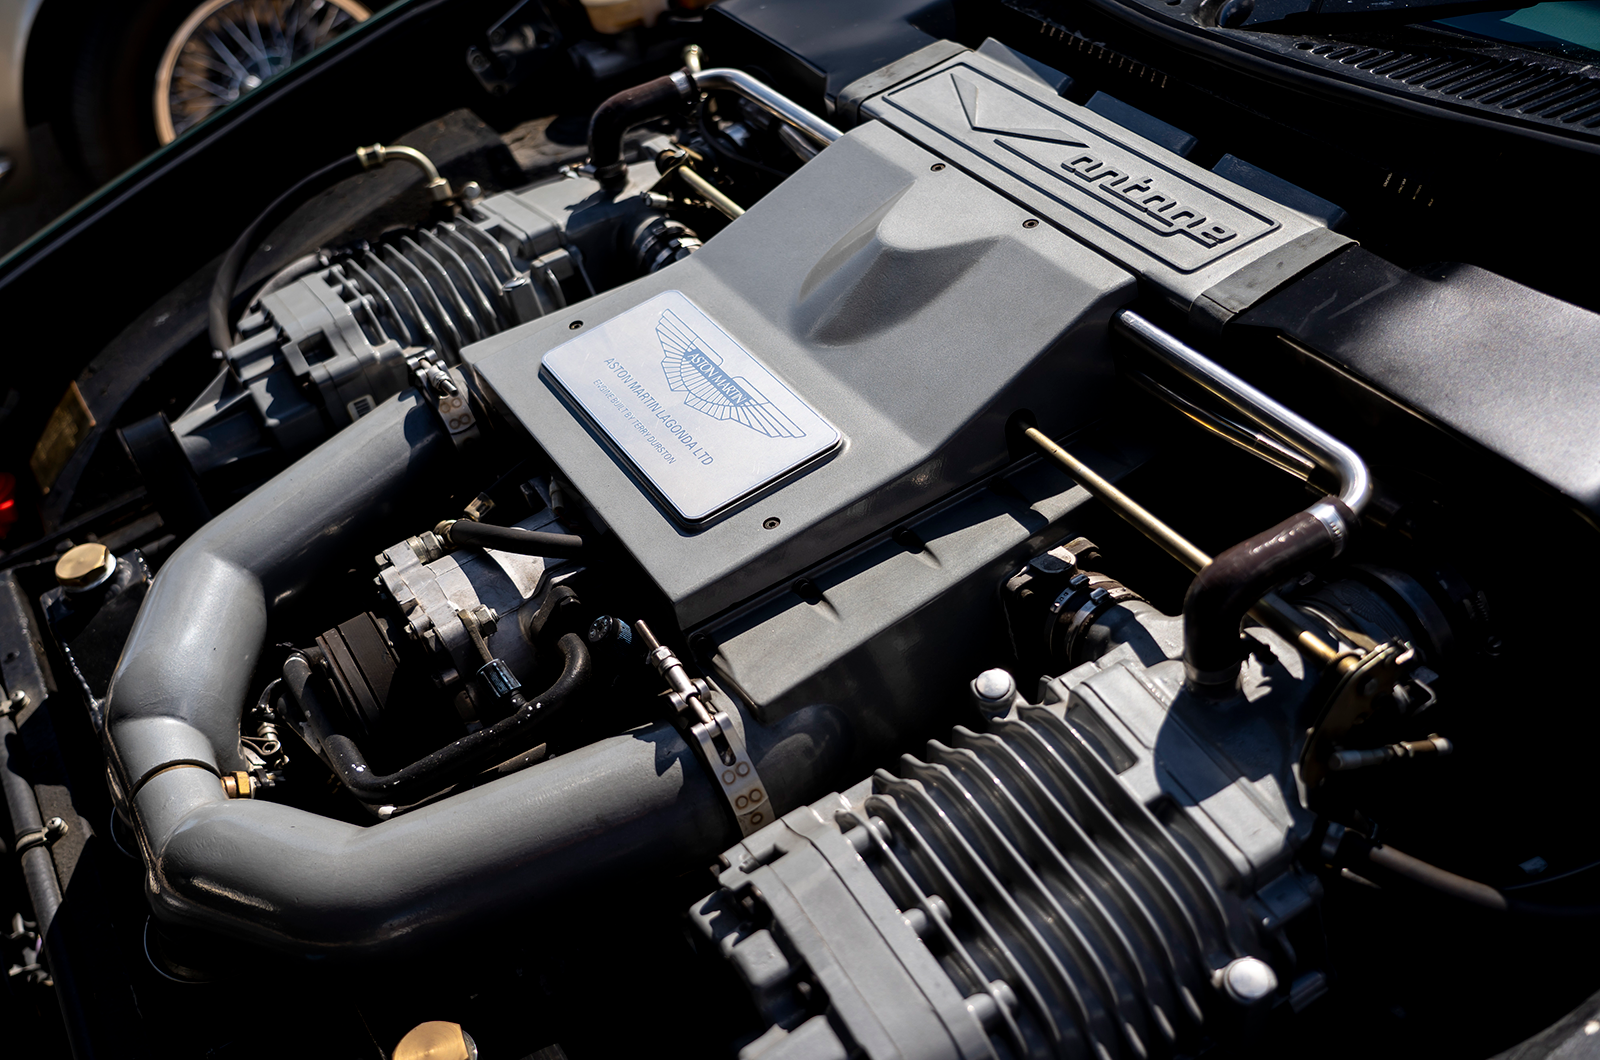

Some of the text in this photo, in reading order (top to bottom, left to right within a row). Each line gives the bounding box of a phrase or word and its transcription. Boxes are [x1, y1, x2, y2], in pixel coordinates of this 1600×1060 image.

[604, 358, 714, 466] ASTON MARTIN LAGONDA LTD
[687, 353, 748, 404] ASTON MARTIN
[593, 379, 677, 464] ENGINE BUILT BY TERRY DURSTON
